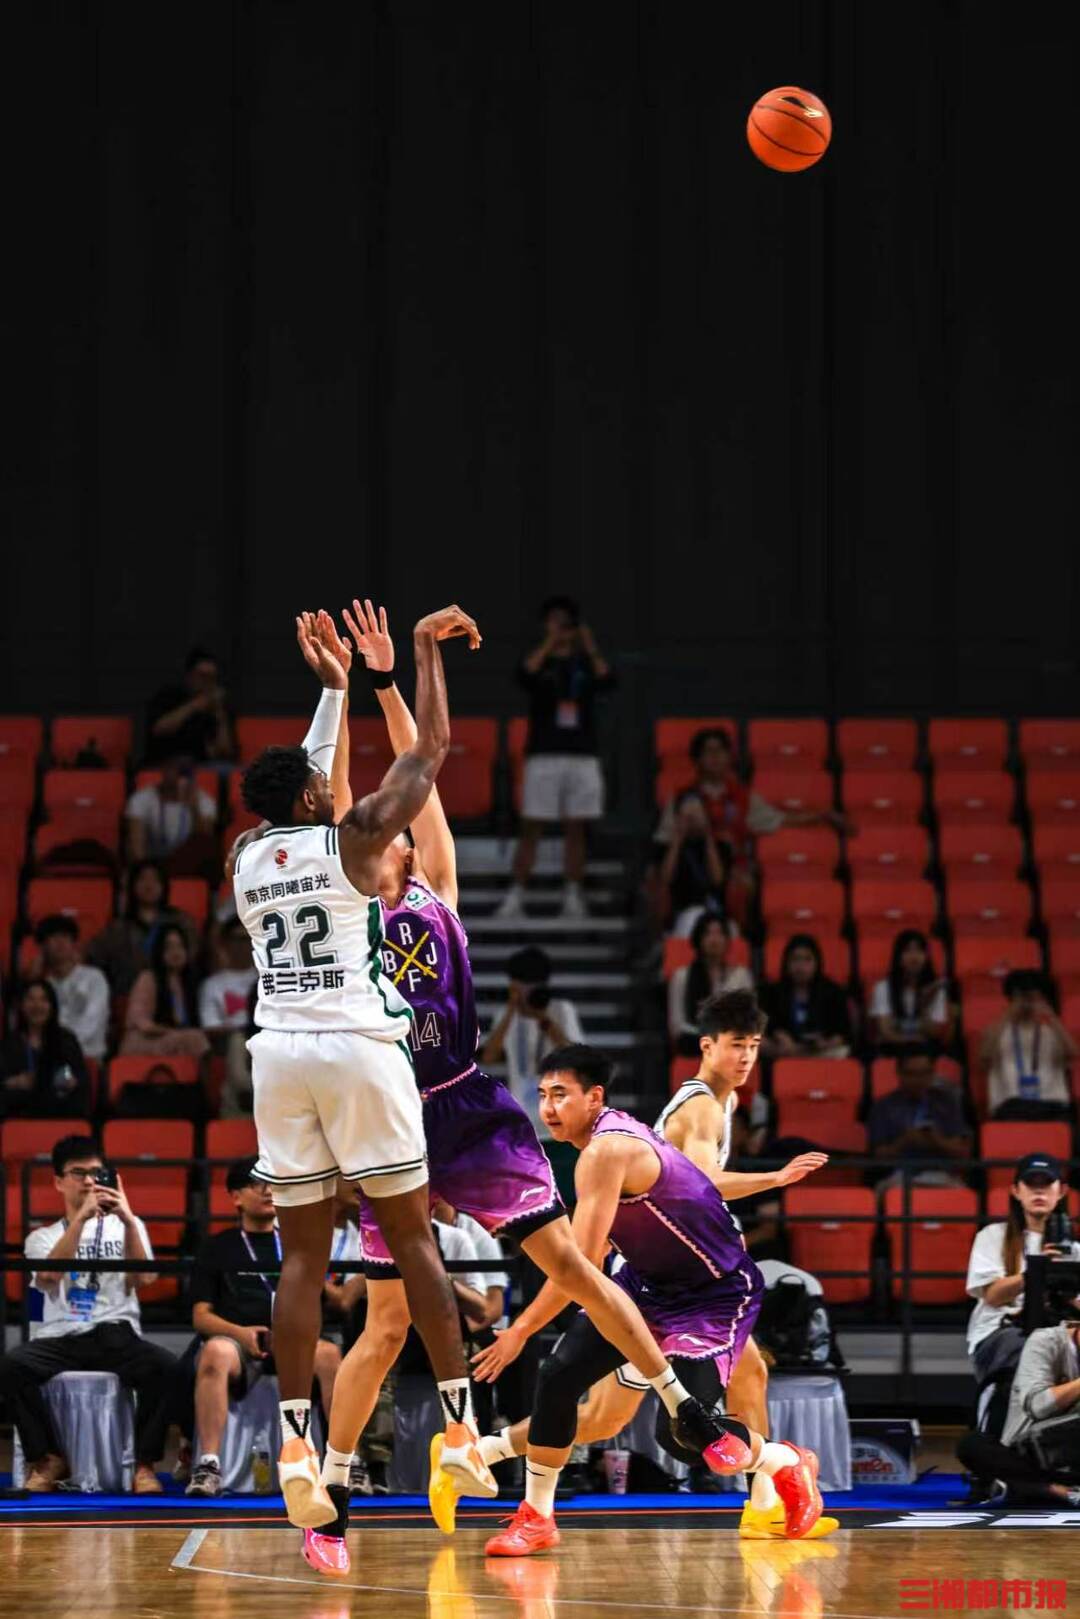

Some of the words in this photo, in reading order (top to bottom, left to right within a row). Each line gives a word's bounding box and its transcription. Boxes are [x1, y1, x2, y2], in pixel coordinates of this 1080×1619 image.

[244, 873, 331, 905] 南京同曦宙光
[261, 900, 339, 968] 22
[262, 970, 345, 996] 弗兰克斯
[410, 1012, 441, 1052] 14
